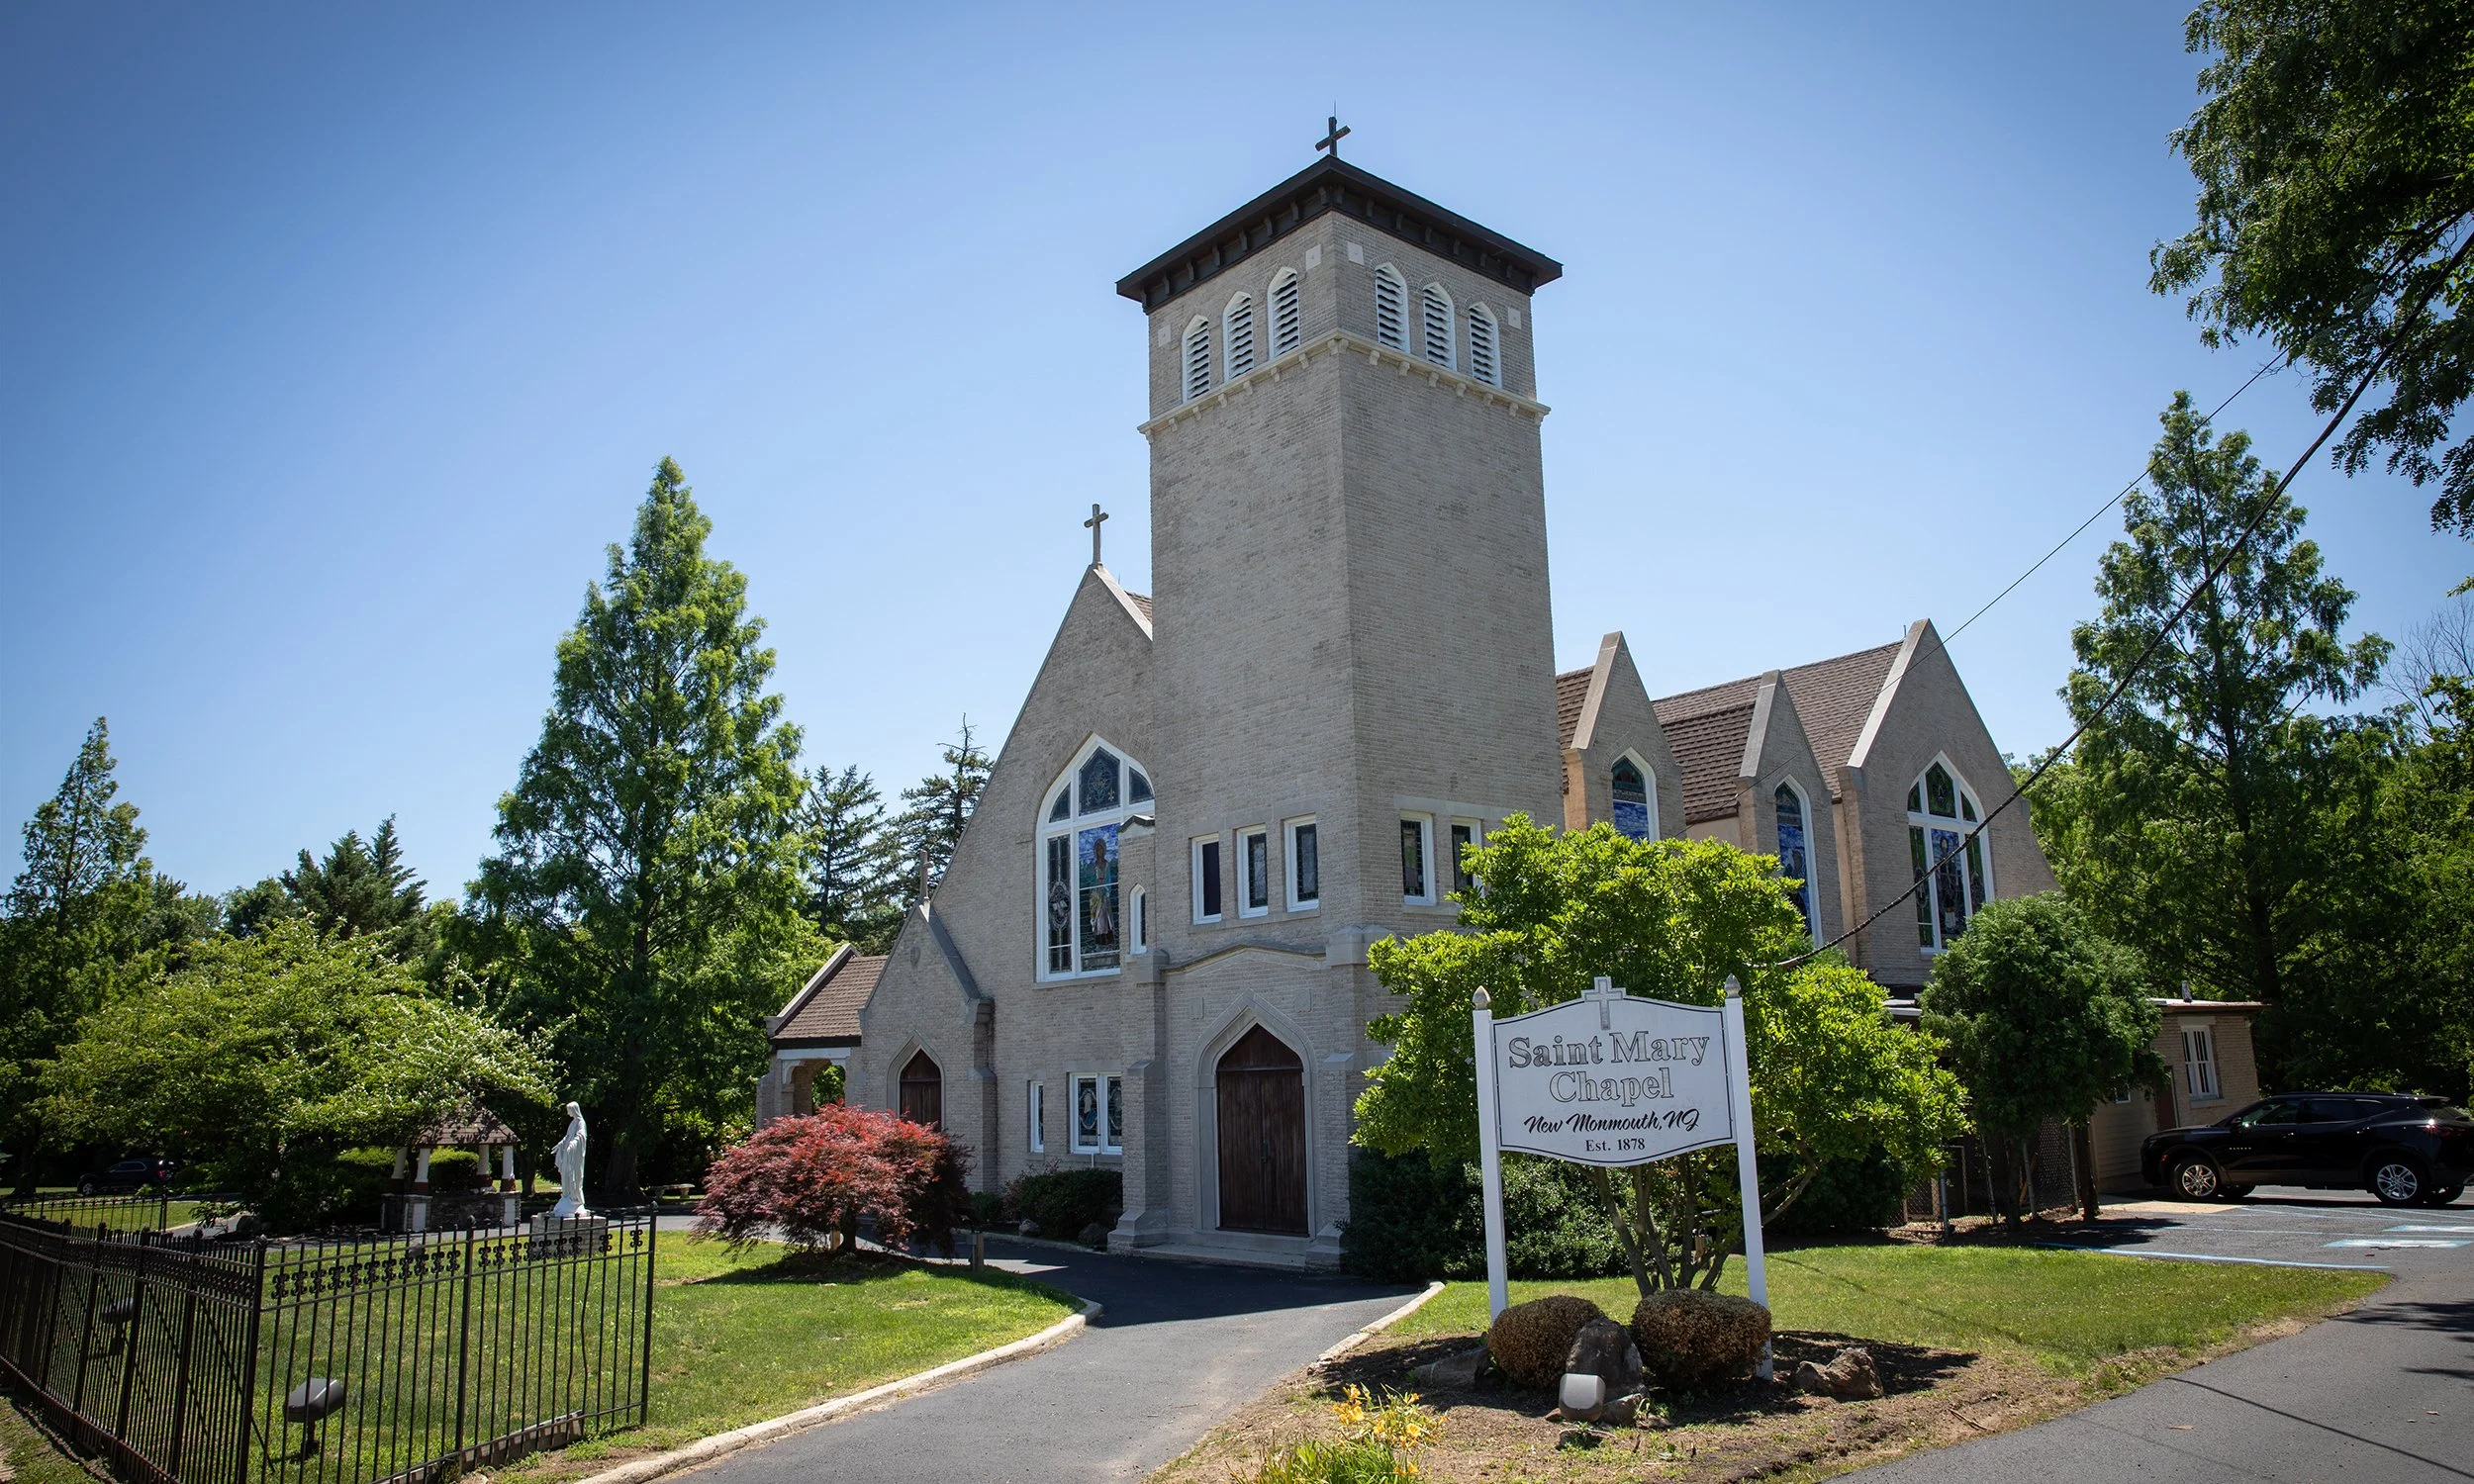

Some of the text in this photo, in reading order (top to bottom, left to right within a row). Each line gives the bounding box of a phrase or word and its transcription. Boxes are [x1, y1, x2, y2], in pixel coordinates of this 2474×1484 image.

[1508, 1030, 1710, 1068] Saint Mary
[1549, 1067, 1674, 1107] Chapel
[1523, 1108, 1700, 1134] New Monmouth, NJ
[1585, 1138, 1646, 1152] Est. 1878
